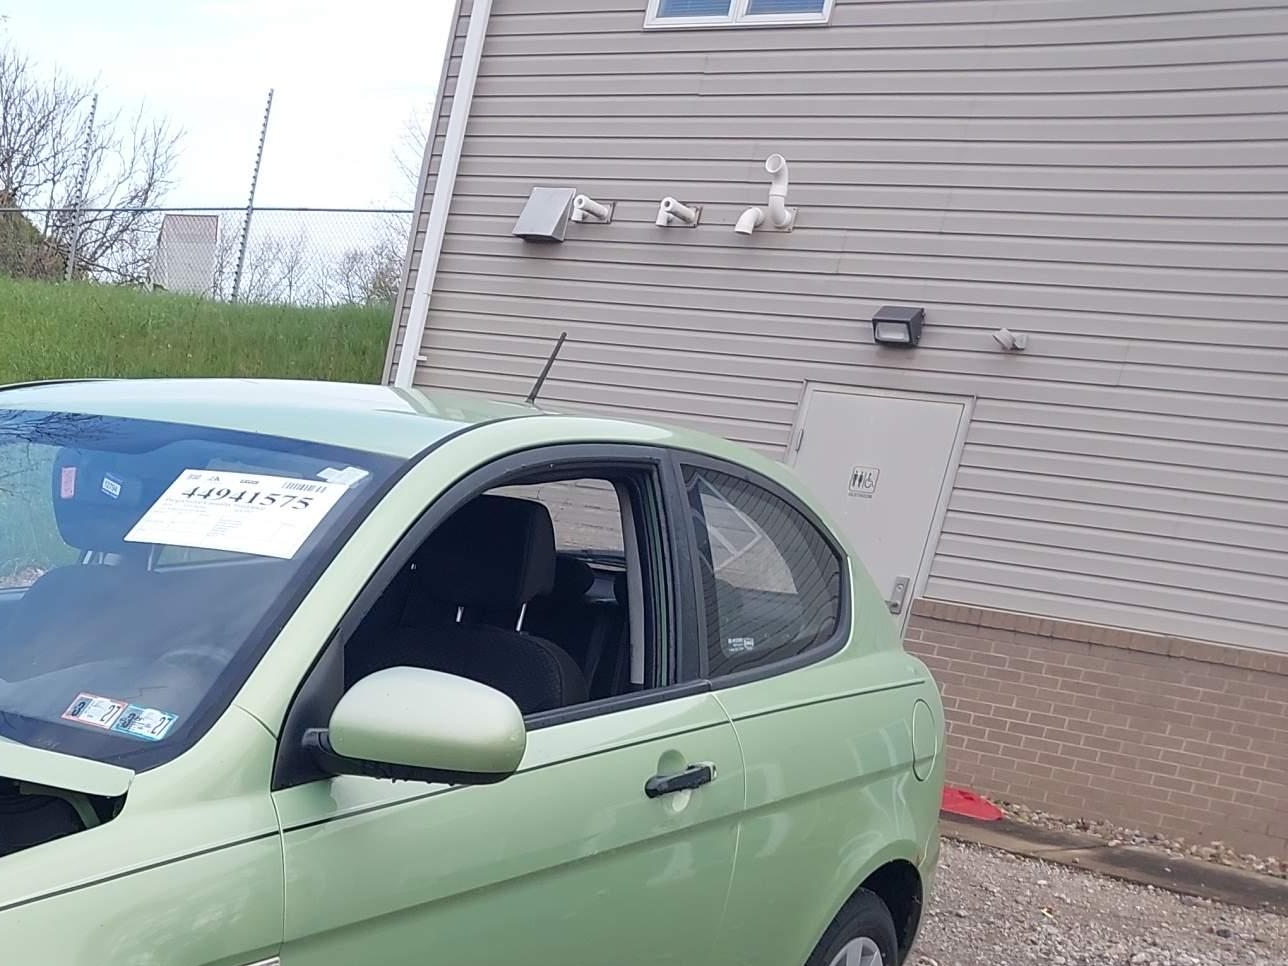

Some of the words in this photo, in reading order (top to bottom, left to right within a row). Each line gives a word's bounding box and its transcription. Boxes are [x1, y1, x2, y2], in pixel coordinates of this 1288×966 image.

[181, 485, 315, 510] 44941575
[100, 704, 121, 725] 27
[151, 716, 173, 737] 27
